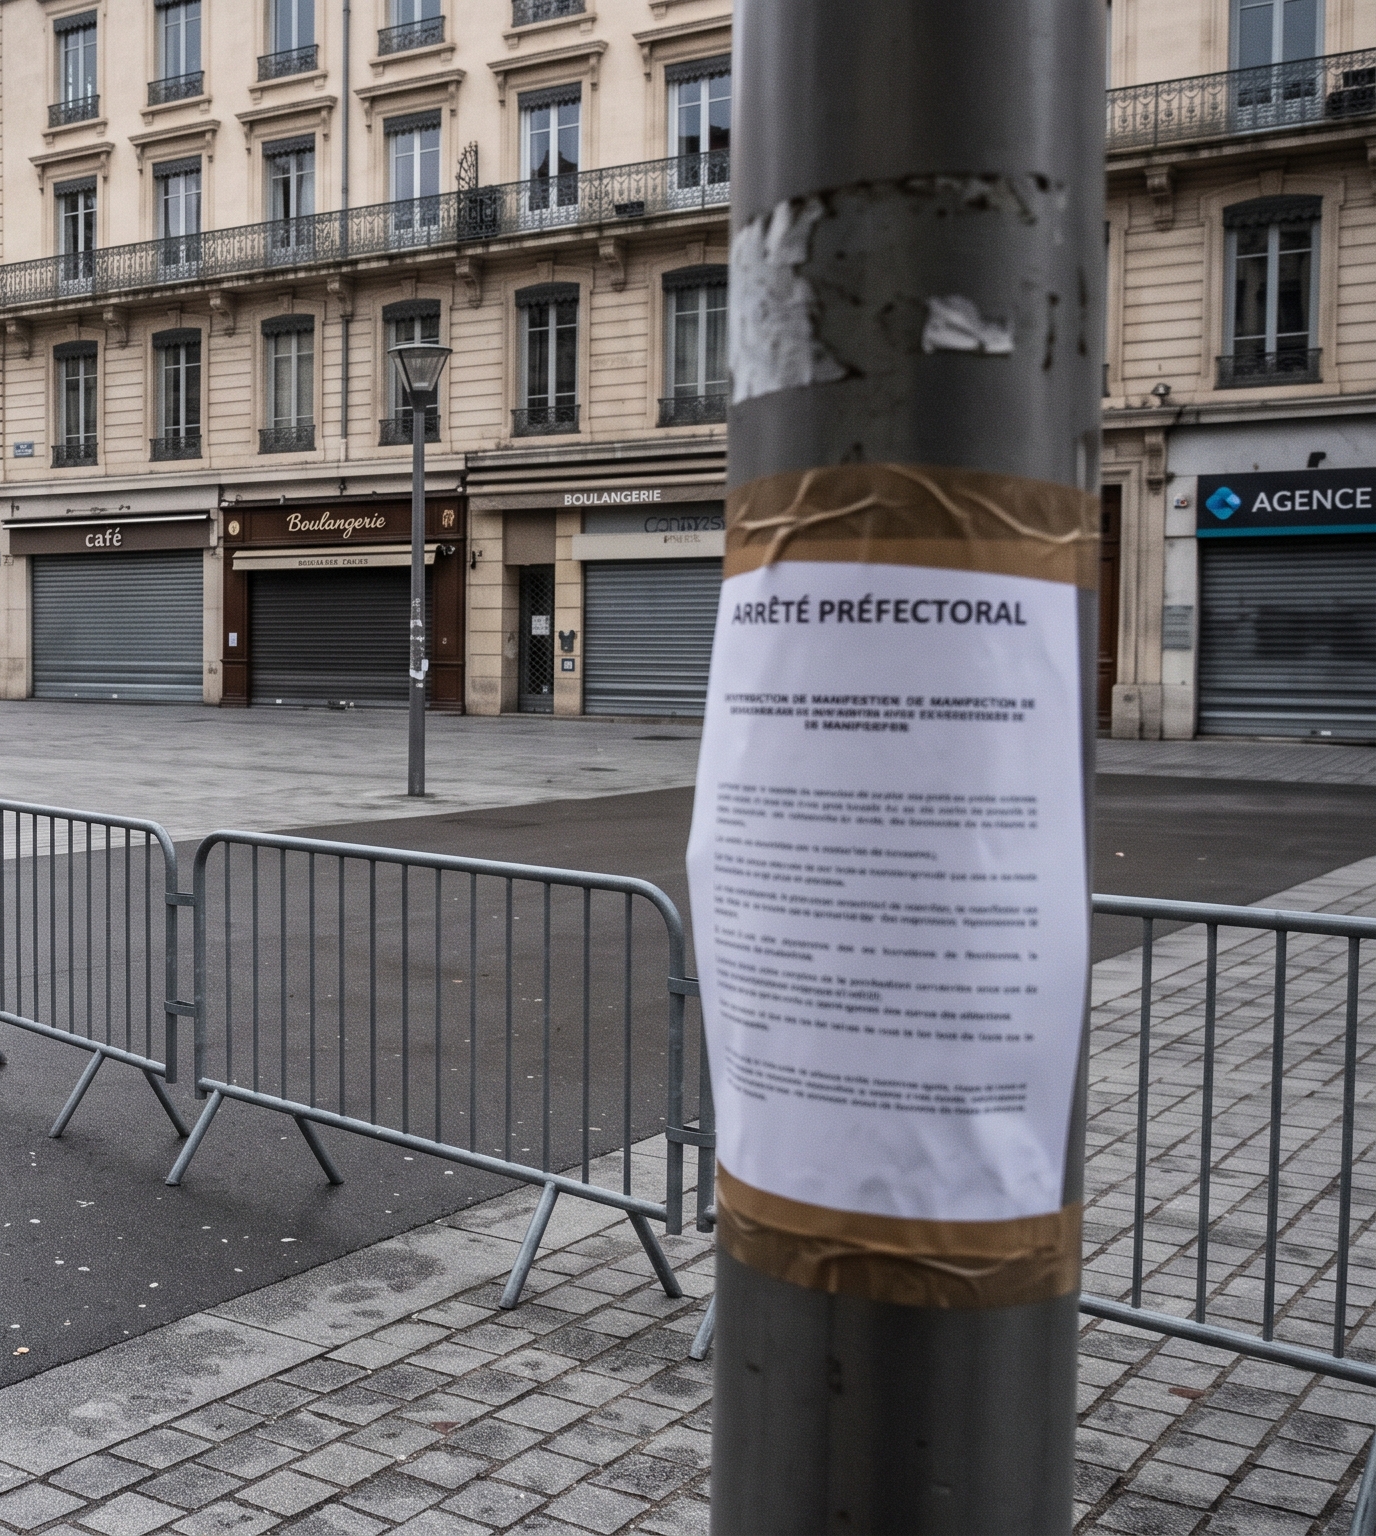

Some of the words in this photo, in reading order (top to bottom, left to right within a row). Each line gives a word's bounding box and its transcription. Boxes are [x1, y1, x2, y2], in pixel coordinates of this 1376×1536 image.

[564, 490, 661, 506] BOULANGERIE
[1251, 487, 1373, 513] AGENCE
[85, 527, 123, 548] café
[286, 511, 387, 539] Boulangerie
[732, 595, 811, 625] ARRÊTÉ
[818, 593, 1028, 626] PRÉFECTORAL
